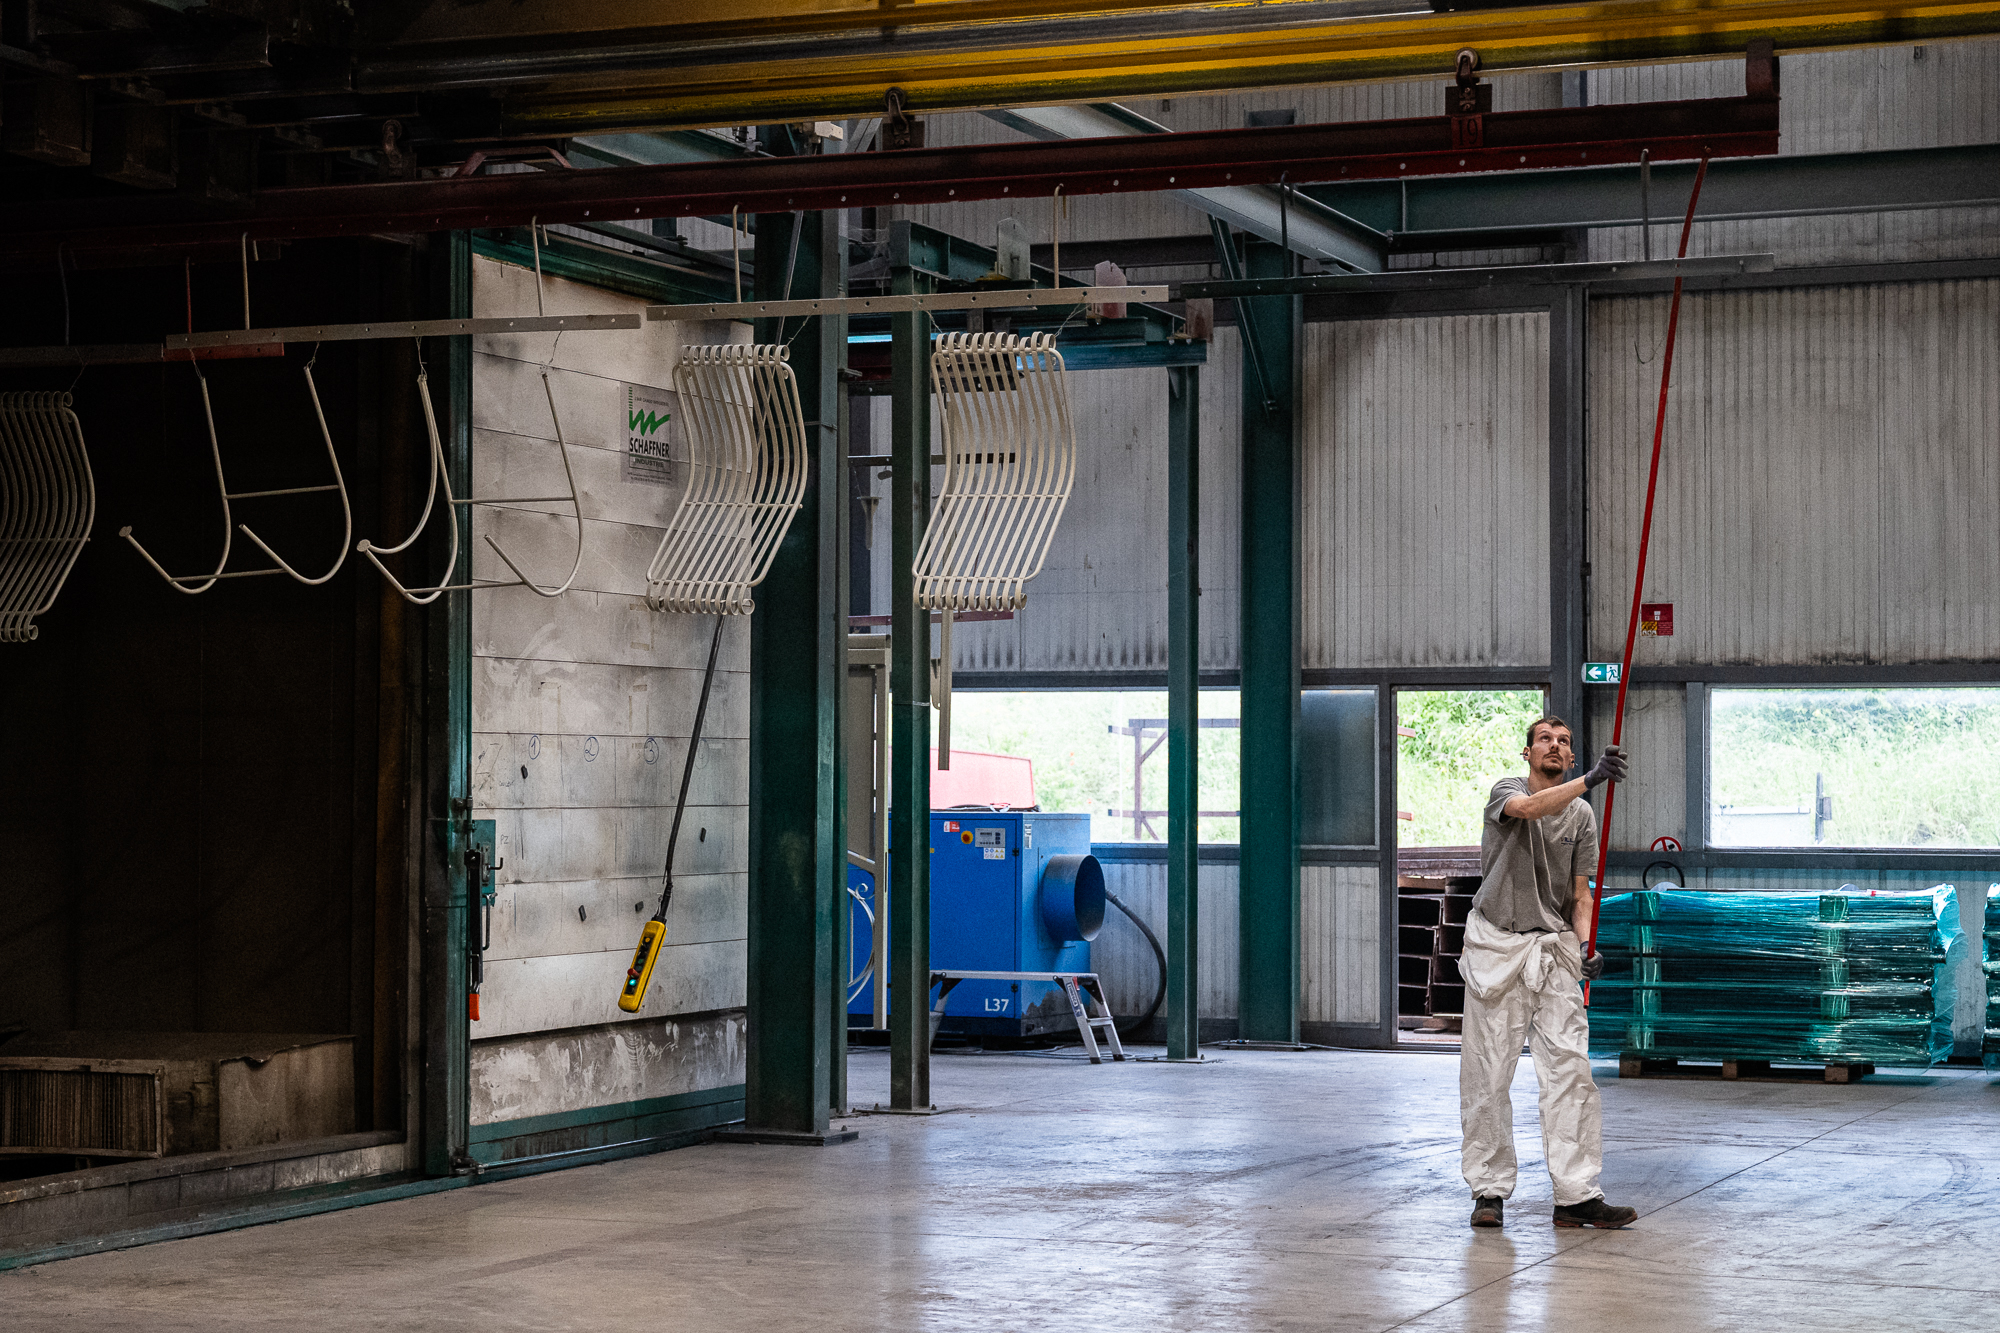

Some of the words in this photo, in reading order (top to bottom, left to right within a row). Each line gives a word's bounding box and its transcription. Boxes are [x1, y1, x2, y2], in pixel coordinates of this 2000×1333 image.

[1458, 118, 1478, 146] 19
[629, 437, 670, 458] SCHAFFNER
[634, 458, 665, 468] INDUSTRIE
[985, 998, 1010, 1012] L37
